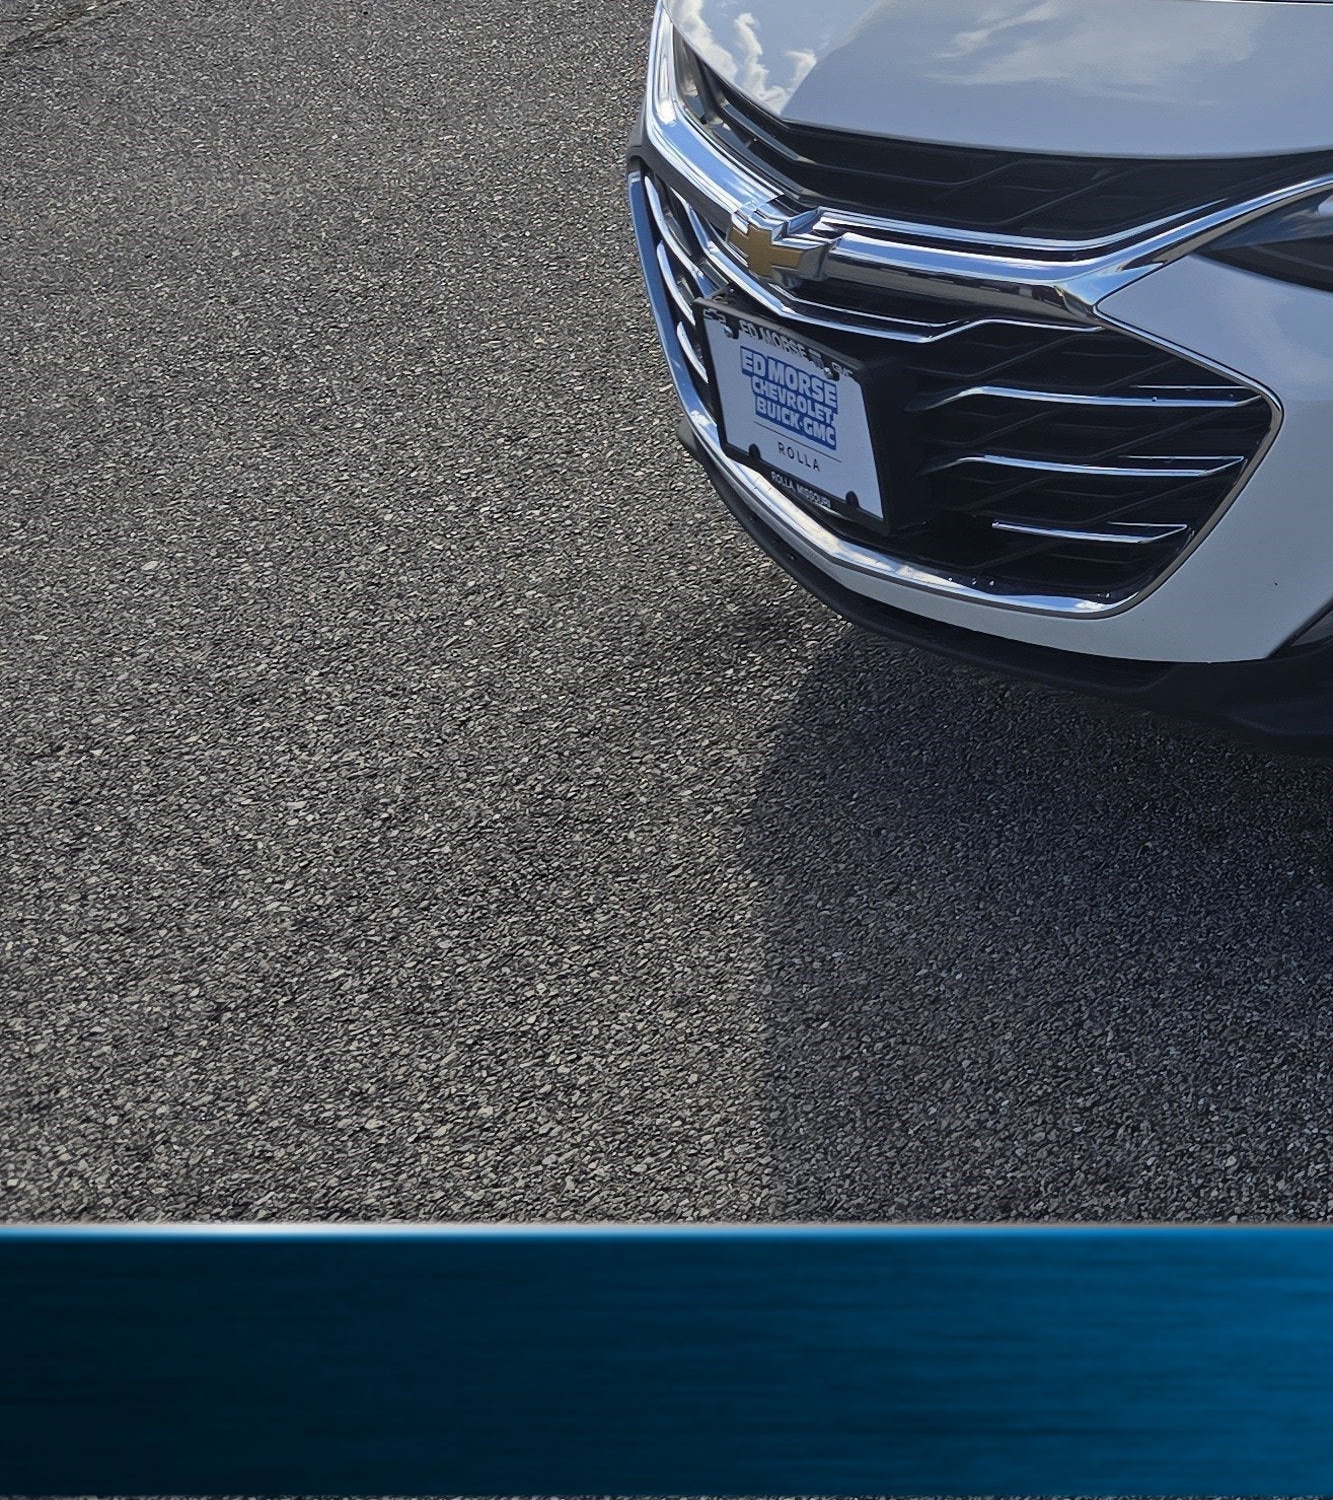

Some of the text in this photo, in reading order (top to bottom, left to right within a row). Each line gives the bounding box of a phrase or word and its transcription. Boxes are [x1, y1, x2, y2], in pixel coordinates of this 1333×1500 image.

[741, 347, 838, 411] ED MORSE
[777, 441, 820, 472] ROLLA
